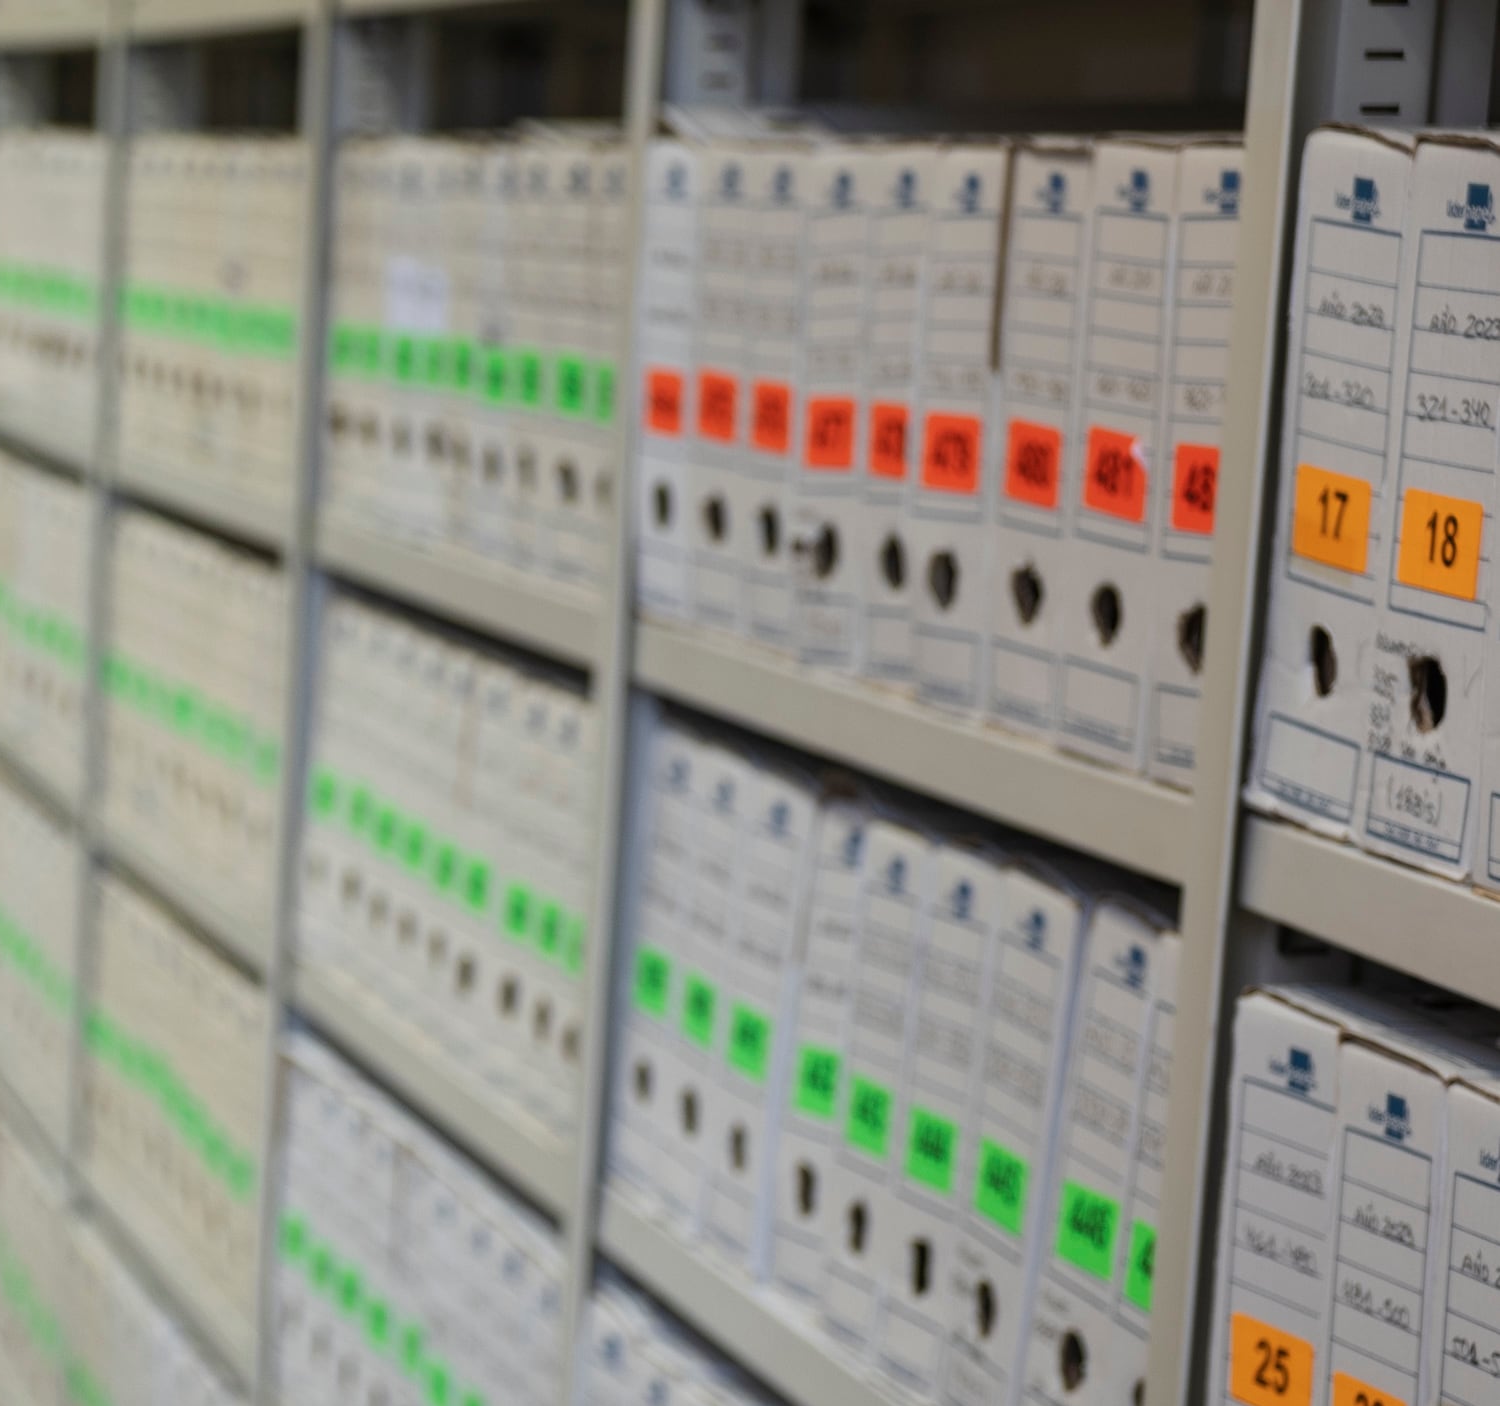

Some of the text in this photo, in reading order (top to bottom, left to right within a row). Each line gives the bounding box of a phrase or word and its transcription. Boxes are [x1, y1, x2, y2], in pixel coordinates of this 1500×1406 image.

[1317, 483, 1350, 541] 17
[1425, 508, 1460, 569] 18
[1253, 1339, 1291, 1396] 25
